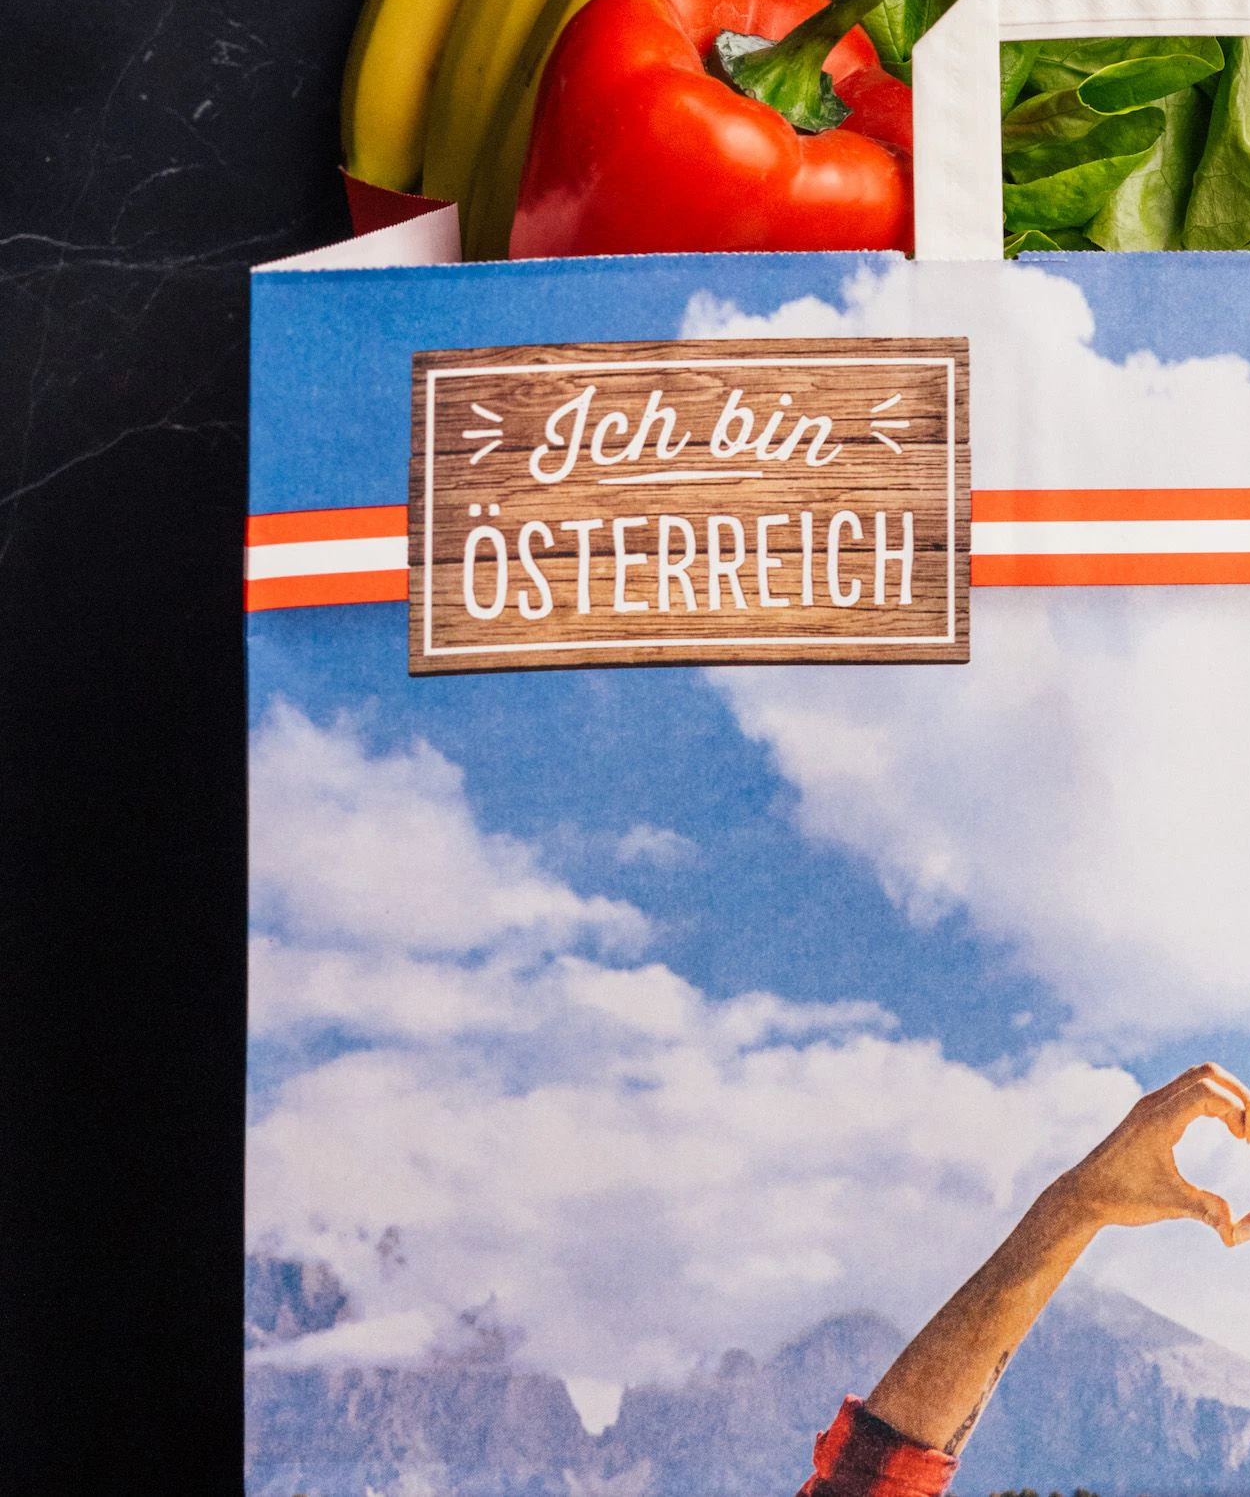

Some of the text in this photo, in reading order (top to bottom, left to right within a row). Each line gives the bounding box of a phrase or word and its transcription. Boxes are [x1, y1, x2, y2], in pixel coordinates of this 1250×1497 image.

[528, 385, 843, 484] Ich bin
[463, 503, 914, 620] ÖSTERREICH
